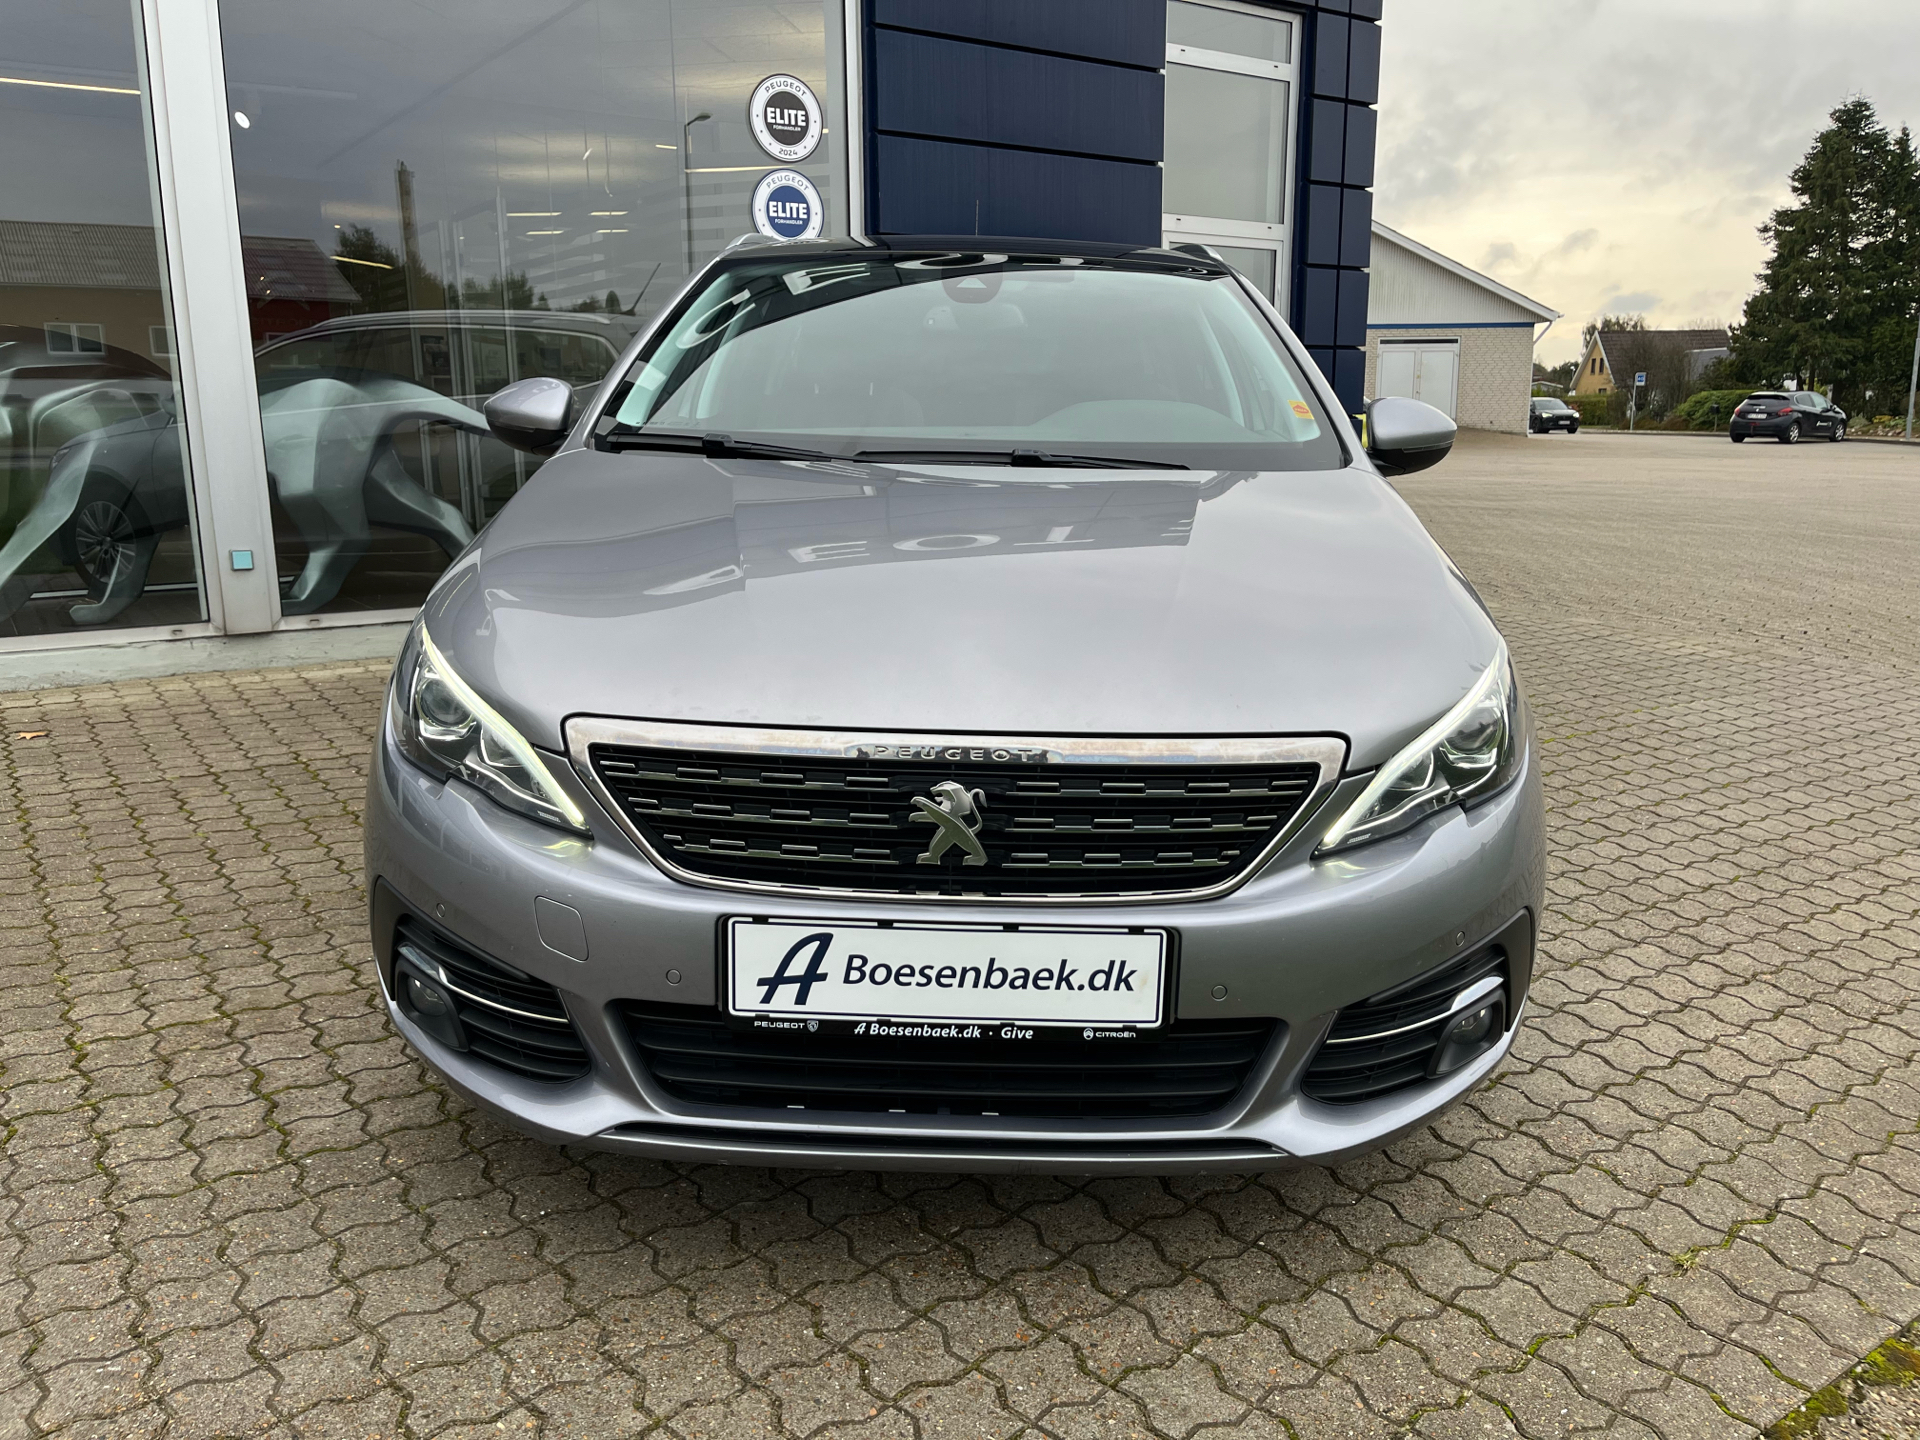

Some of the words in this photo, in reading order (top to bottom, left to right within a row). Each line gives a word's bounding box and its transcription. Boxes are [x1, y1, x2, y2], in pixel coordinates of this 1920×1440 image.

[764, 80, 807, 97] PEUGEOT
[766, 107, 806, 126] ELITE
[778, 148, 798, 156] 2024
[766, 174, 809, 191] PEUGEOT
[769, 201, 808, 219] ELITE
[874, 745, 1033, 762] PEUGEOT
[842, 953, 1138, 992] Boesenbaek.dk
[754, 1020, 805, 1029] PEUGEOT
[869, 1022, 982, 1038] Boesenbaek.dk
[1000, 1026, 1034, 1039] Give
